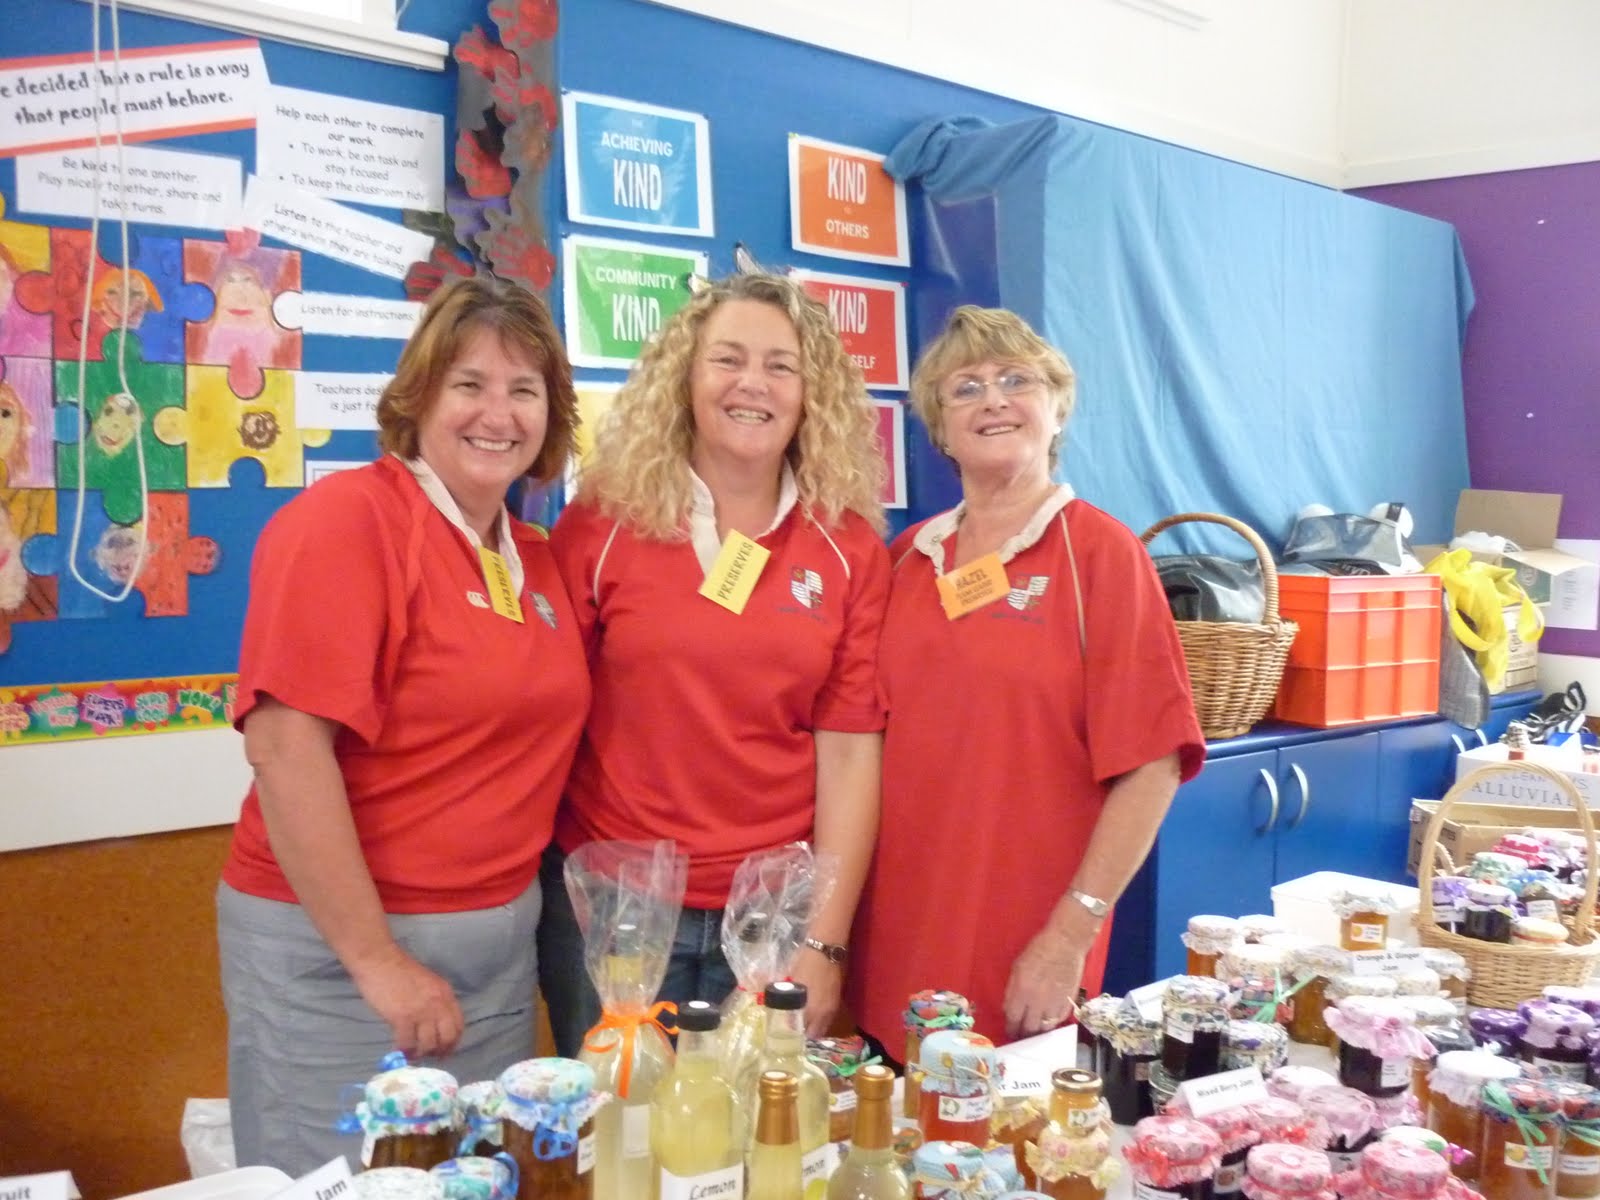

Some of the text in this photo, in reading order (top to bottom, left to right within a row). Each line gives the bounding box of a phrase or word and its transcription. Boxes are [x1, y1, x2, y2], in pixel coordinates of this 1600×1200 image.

[0, 62, 250, 98] e decided hat a rule is a way
[15, 87, 234, 126] that people must behave.
[275, 104, 425, 140] Help each other to complete
[328, 130, 345, 142] our
[601, 131, 674, 158] ACHIEVING
[62, 155, 78, 170] Be
[128, 167, 149, 178] one
[301, 142, 315, 154] To
[348, 149, 362, 161] be
[363, 152, 375, 163] on
[378, 154, 399, 167] task
[401, 157, 419, 170] and
[292, 172, 305, 186] To
[309, 175, 333, 191] keep
[335, 180, 353, 193] the
[324, 162, 389, 182] stay focused
[827, 155, 867, 206] KIND
[37, 169, 63, 189] Play
[107, 181, 164, 199] toether,
[166, 187, 199, 201] share
[613, 157, 663, 211] KIND
[274, 202, 308, 223] Listen
[312, 216, 323, 229] to
[825, 218, 871, 240] OTHERS
[596, 265, 677, 290] COMMUNITY
[301, 304, 335, 316] Listen
[336, 304, 354, 316] for
[612, 292, 661, 342] KIND
[828, 288, 868, 335] KIND
[849, 353, 877, 370] SELF
[315, 382, 362, 395] Teachers
[329, 401, 377, 415] is just fo
[717, 541, 755, 601] PRESERVES
[1356, 953, 1385, 963] Orange
[1395, 951, 1420, 961] Ginger
[1381, 964, 1399, 972] Jam
[1011, 1080, 1042, 1091] Jam
[801, 1159, 826, 1177] mon
[689, 1178, 738, 1200] Lemon
